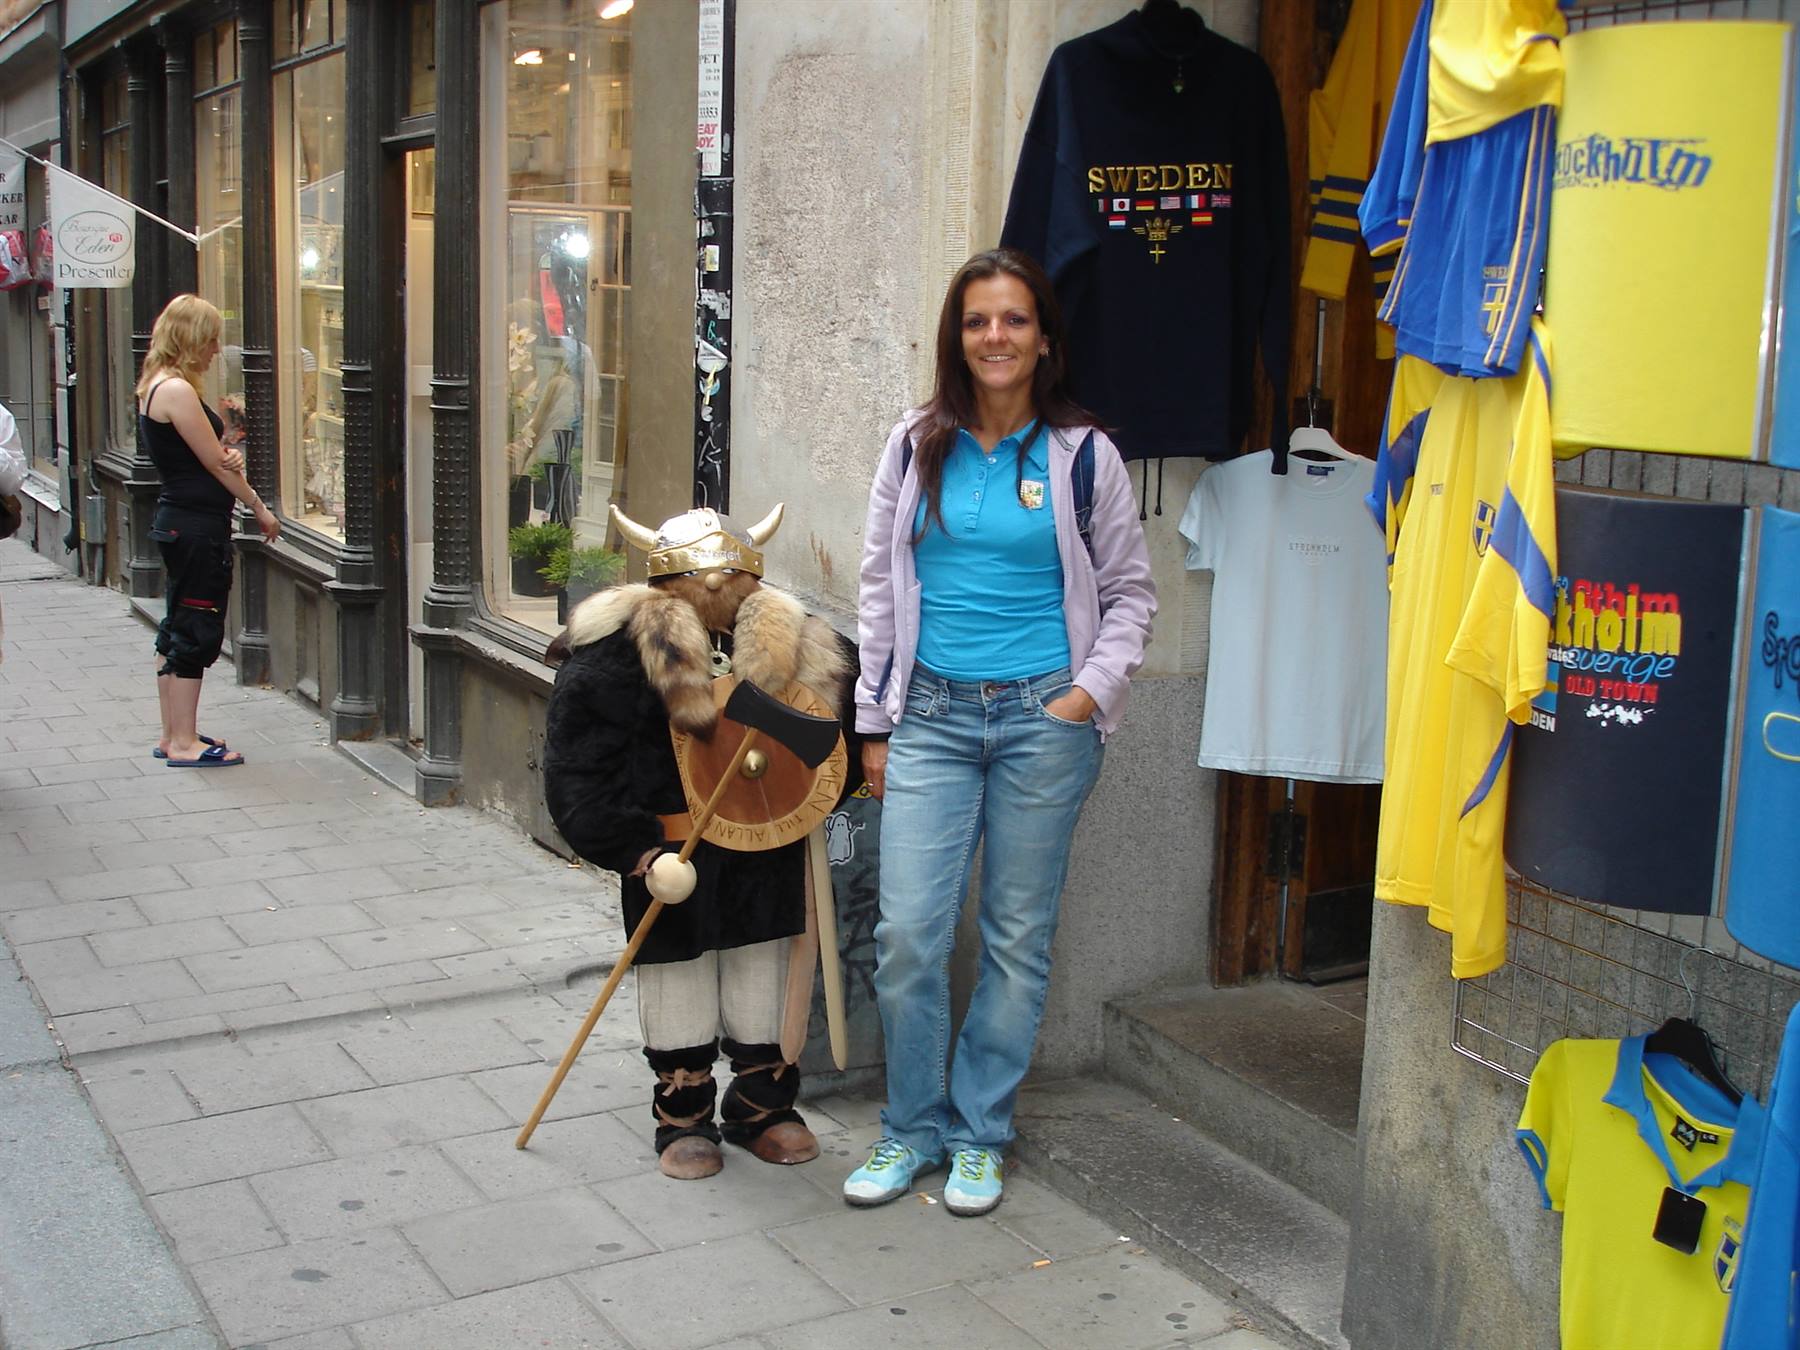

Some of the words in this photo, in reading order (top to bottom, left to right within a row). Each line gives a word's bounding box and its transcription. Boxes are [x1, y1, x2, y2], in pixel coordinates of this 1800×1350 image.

[698, 123, 719, 135] EAT
[1088, 164, 1233, 193] SWEDEN
[0, 192, 24, 204] KER
[75, 235, 115, 255] Eden
[59, 263, 131, 279] Presenter
[1554, 587, 1682, 657] kholm
[1563, 647, 1676, 685] Sverige
[1565, 673, 1595, 697] OLD
[1600, 680, 1658, 704] TOWN
[1529, 710, 1556, 733] DEN
